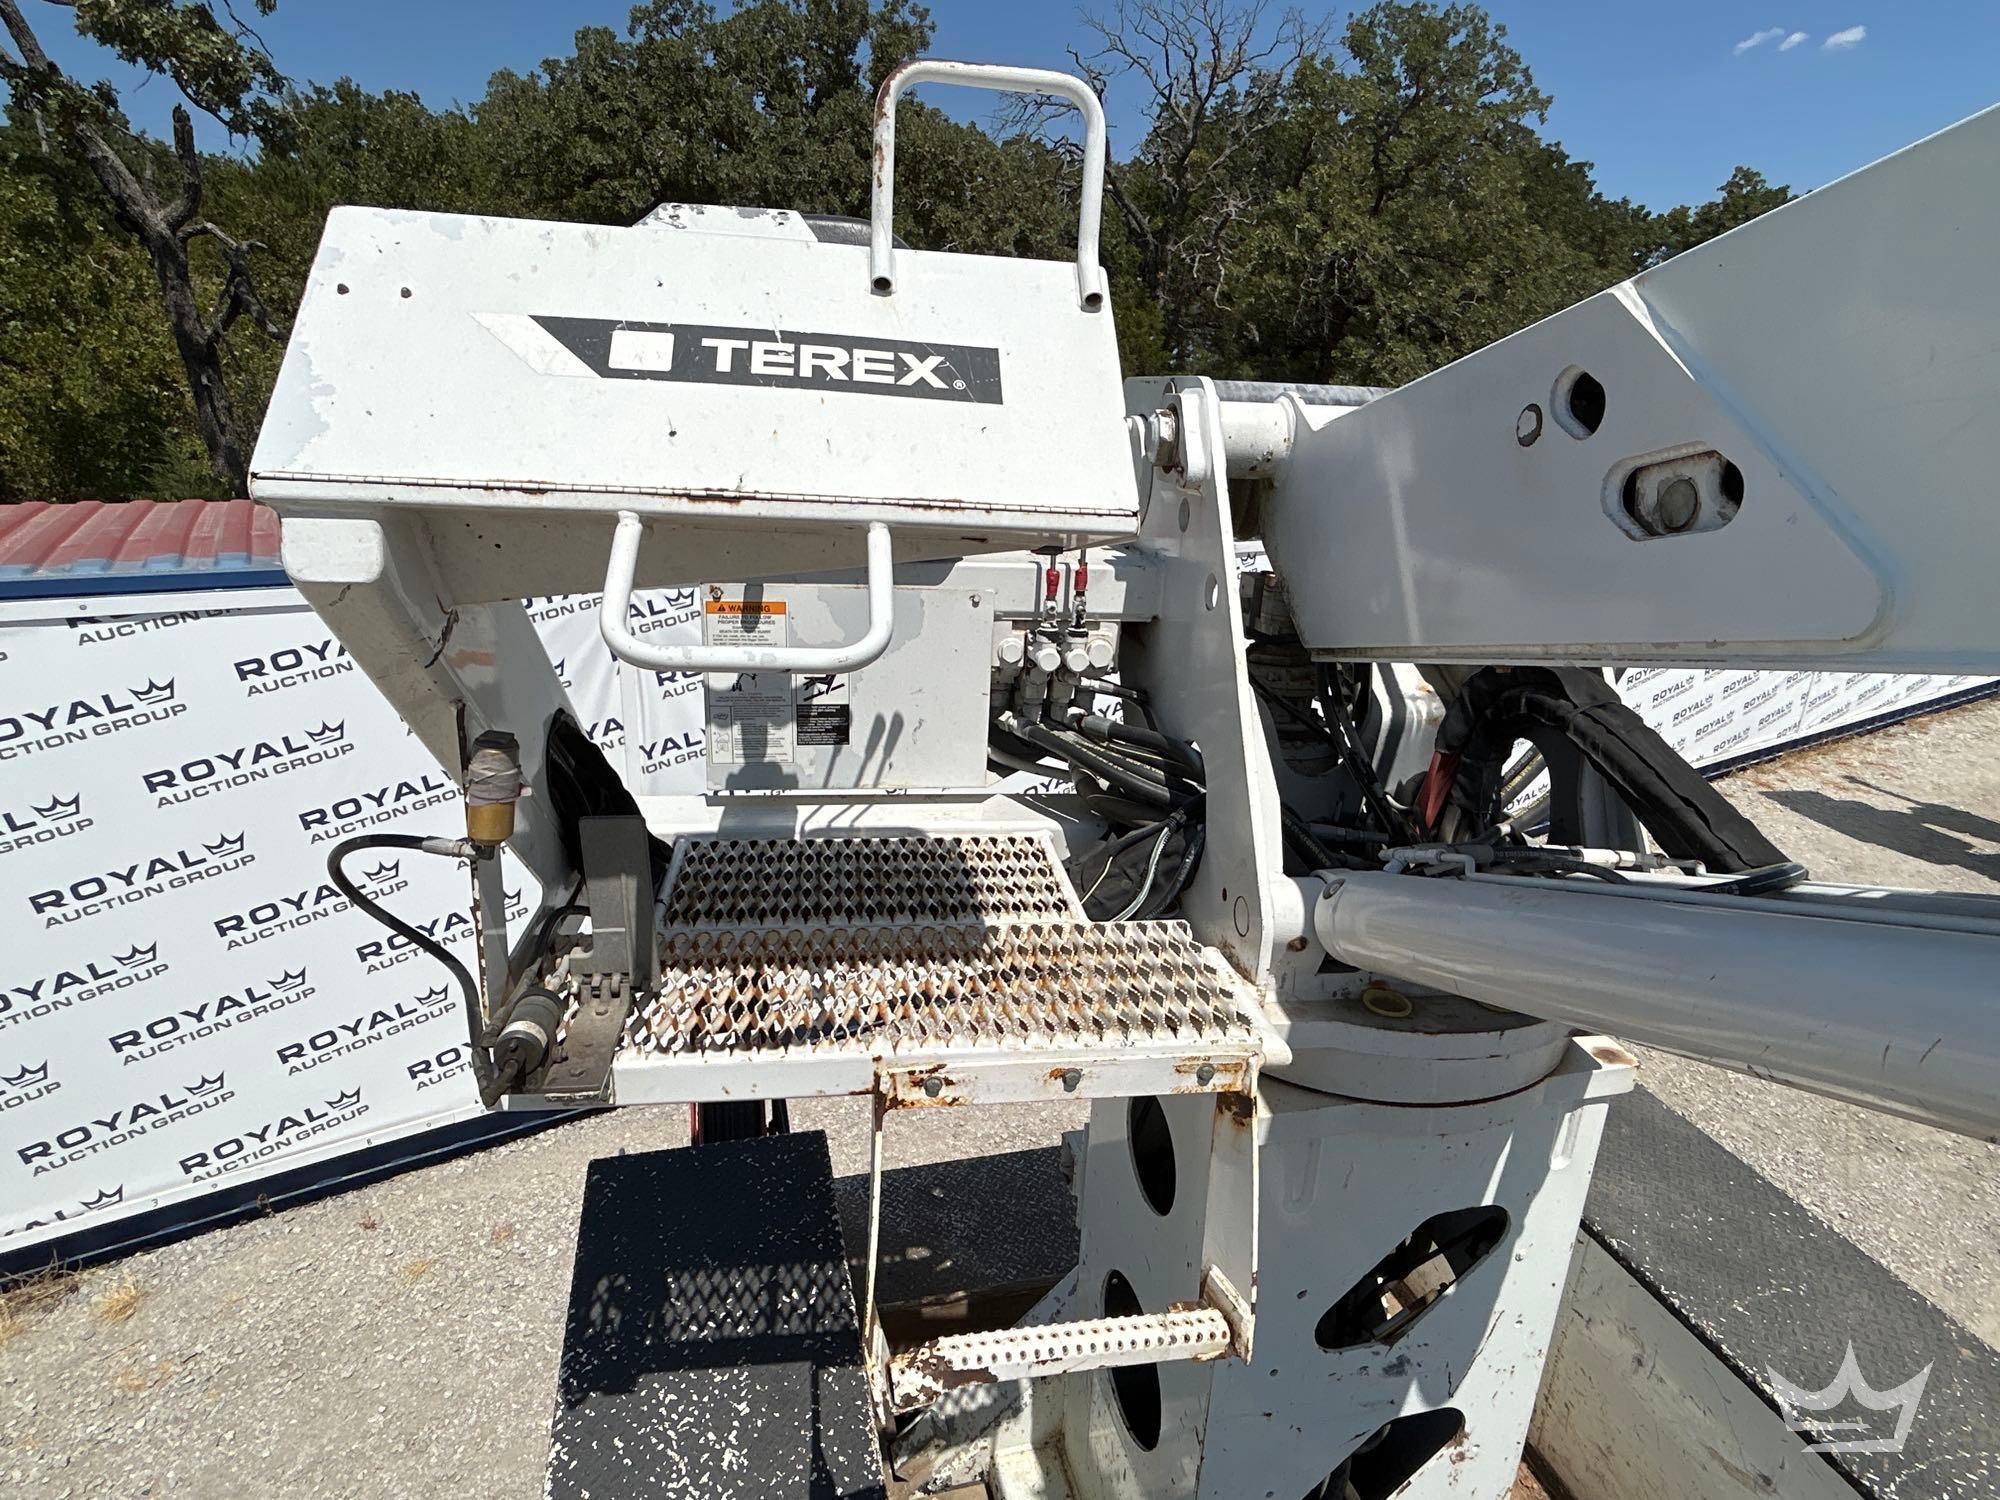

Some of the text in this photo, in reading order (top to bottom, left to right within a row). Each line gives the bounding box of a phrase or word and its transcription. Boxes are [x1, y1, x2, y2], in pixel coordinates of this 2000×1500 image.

[701, 338, 949, 389] TEREX
[639, 610, 702, 634] GROUP
[728, 605, 771, 613] WARNING
[247, 660, 354, 697] AUCTION
[1652, 681, 1685, 703] ROYAL
[1723, 673, 1752, 694] ROYAL
[92, 703, 188, 737] GROUP
[1673, 700, 1705, 722] ROYAL
[1695, 715, 1726, 737] ROYAL
[142, 736, 309, 793] ROYAL
[1713, 732, 1743, 753] ROYAL
[157, 742, 355, 809] AUCTION GROUP
[298, 775, 445, 831] ROYAL
[310, 805, 408, 845] AUCTION
[28, 850, 208, 915] ROYAL
[45, 854, 256, 930] AUCTION GROUP
[227, 907, 329, 951] AUCTION
[77, 963, 169, 1002] GROUP
[108, 987, 272, 1053] ROYAL
[123, 987, 316, 1066] AUCTION GROUP
[276, 1002, 418, 1065] ROYAL
[288, 1031, 383, 1076] AUCTION
[386, 1002, 457, 1036] GROUP
[0, 1081, 61, 1112] OUP
[17, 1094, 188, 1165] ROYAL
[33, 1090, 235, 1177] AUCTION GROUP
[178, 1108, 329, 1175] ROYAL
[192, 1104, 370, 1184] AUCTION GROUP
